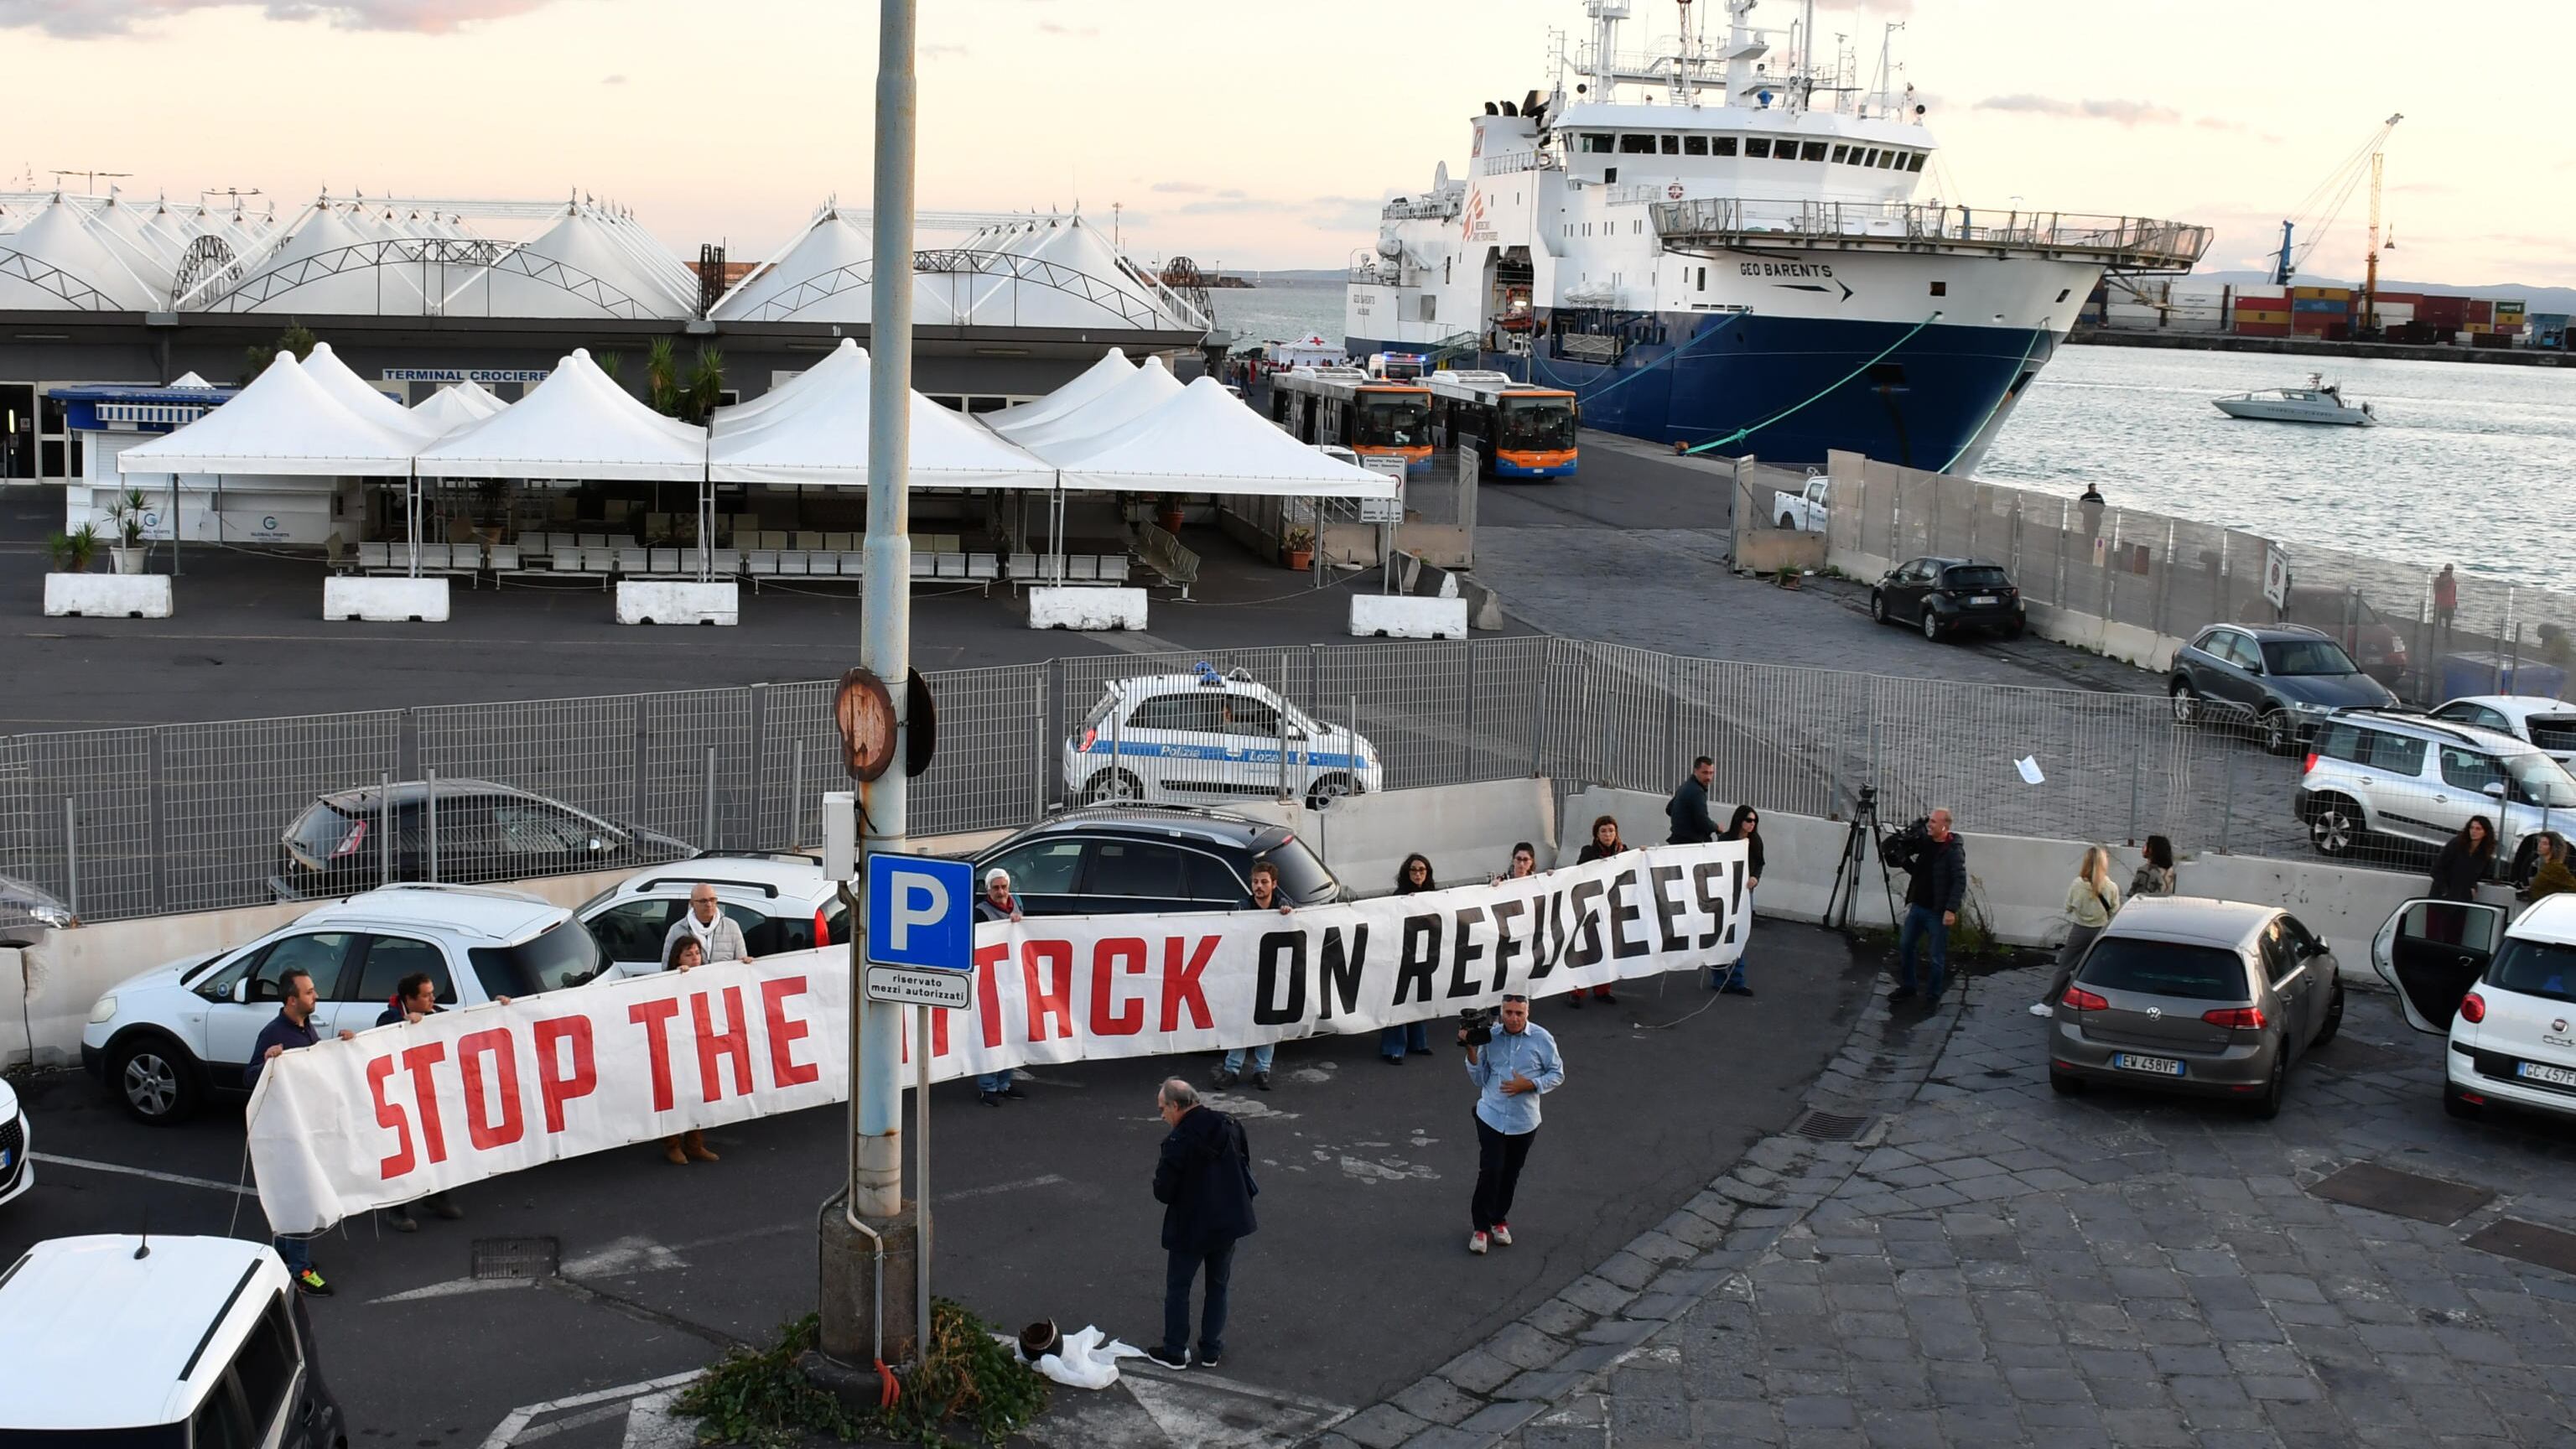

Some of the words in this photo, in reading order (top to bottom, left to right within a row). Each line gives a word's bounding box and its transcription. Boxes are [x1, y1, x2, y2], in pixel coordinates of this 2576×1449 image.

[1740, 262, 1760, 276] GEO
[1763, 263, 1833, 278] BARENTS
[385, 370, 464, 381] TERMINAL
[470, 371, 546, 381] CROCIERE
[1161, 745, 1201, 758] Polizia
[891, 870, 949, 951] P
[892, 974, 943, 987] riservato
[871, 984, 901, 995] mezzi
[906, 987, 964, 1001] autorizzati
[366, 1014, 598, 1180] STOP
[629, 976, 819, 1112] THE
[902, 934, 1222, 1063] TACK
[1254, 922, 1368, 1026] ON
[1392, 860, 1746, 1007] REFUGEES!
[2123, 1055, 2137, 1067] EW
[2141, 1058, 2177, 1072] 438VF
